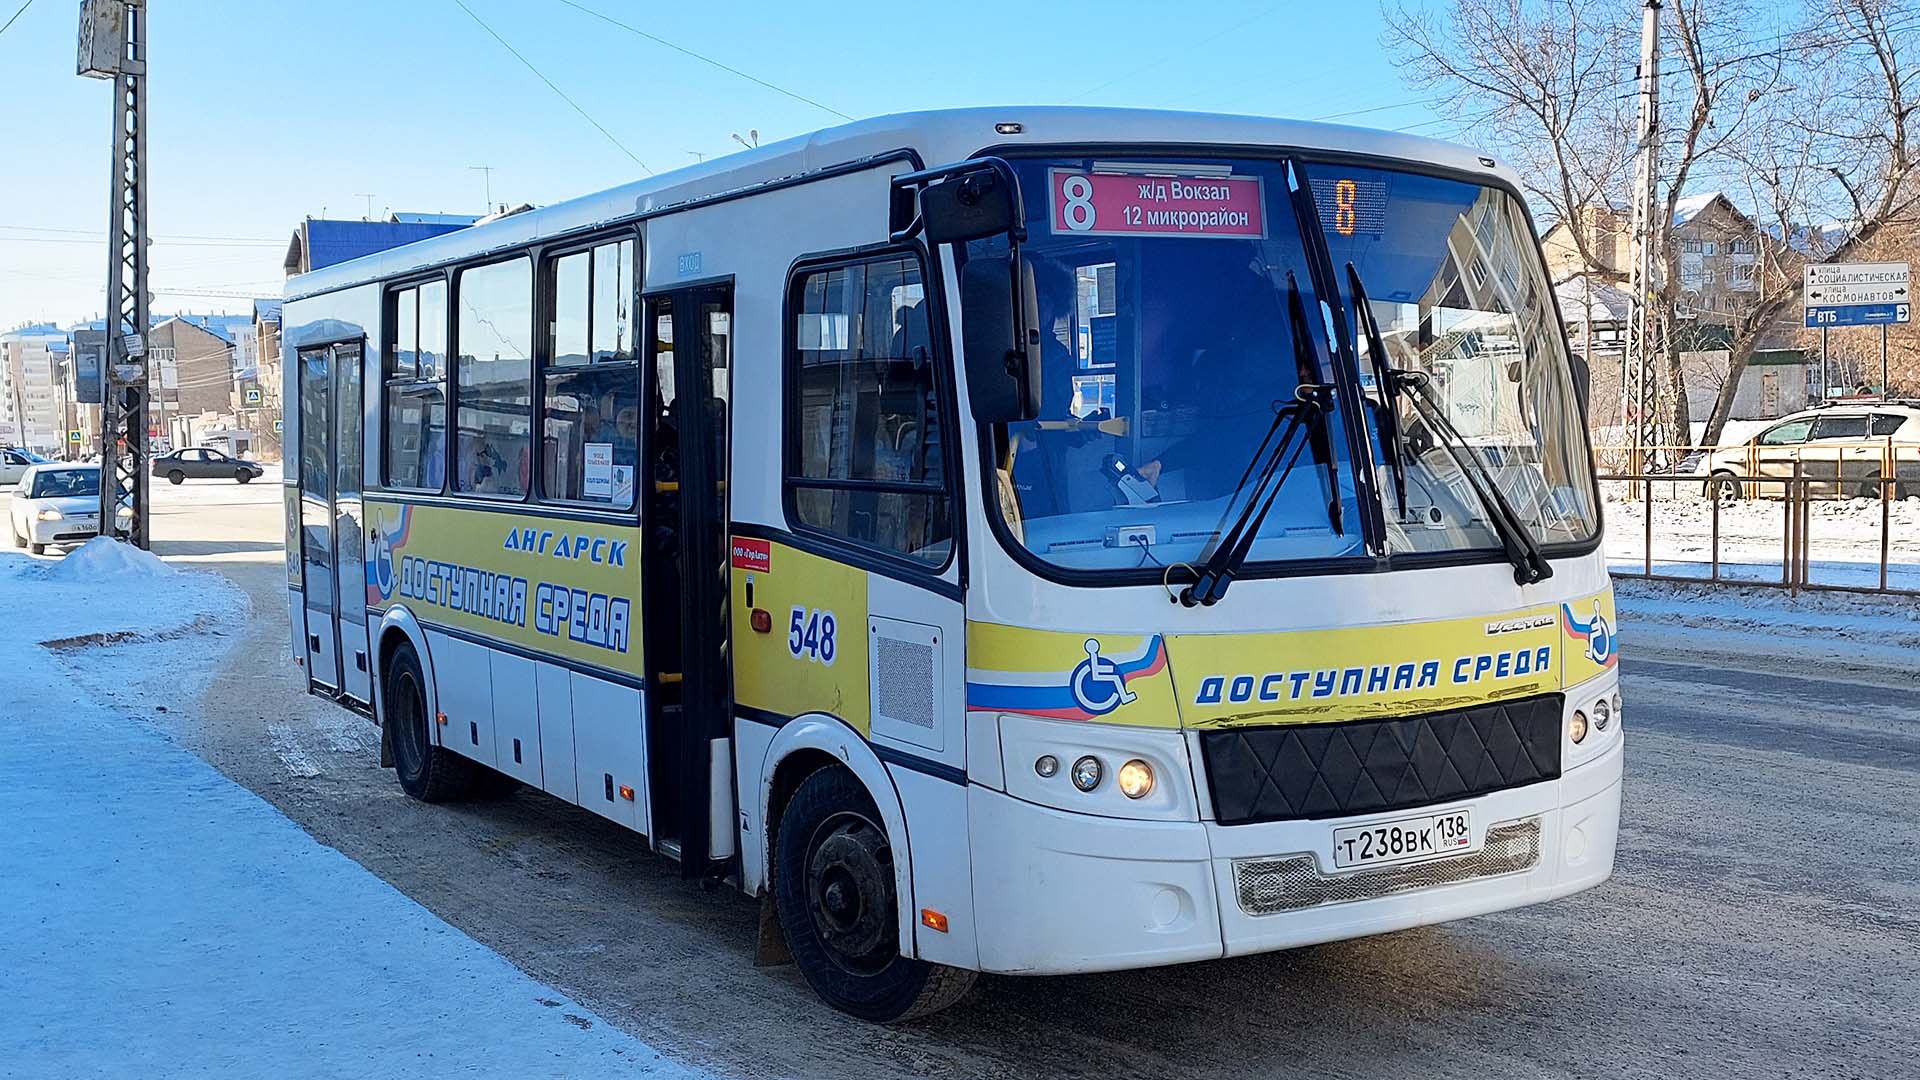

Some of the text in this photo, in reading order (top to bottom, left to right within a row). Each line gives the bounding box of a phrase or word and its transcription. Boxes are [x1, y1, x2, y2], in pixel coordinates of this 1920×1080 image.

[1063, 176, 1096, 231] 8
[1138, 181, 1230, 202] ж/д Вокзал
[1336, 180, 1355, 236] 8
[1123, 206, 1249, 230] 12 микрорайон
[1818, 272, 1908, 284] СОЦИАЛИСТИЧЕСКАЯ
[1823, 292, 1894, 303] КОСМОНАВТОВ
[1817, 311, 1837, 323] ВТБ
[503, 527, 629, 567] АНГАРСК
[400, 555, 630, 653] ДОСТУПНАЯ СРЕДА
[789, 608, 835, 662] 548
[1195, 646, 1551, 704] ДОСТУПНАЯ СРЕДА
[1343, 816, 1465, 861] Т238ВК 138
[1443, 838, 1458, 848] RUS
